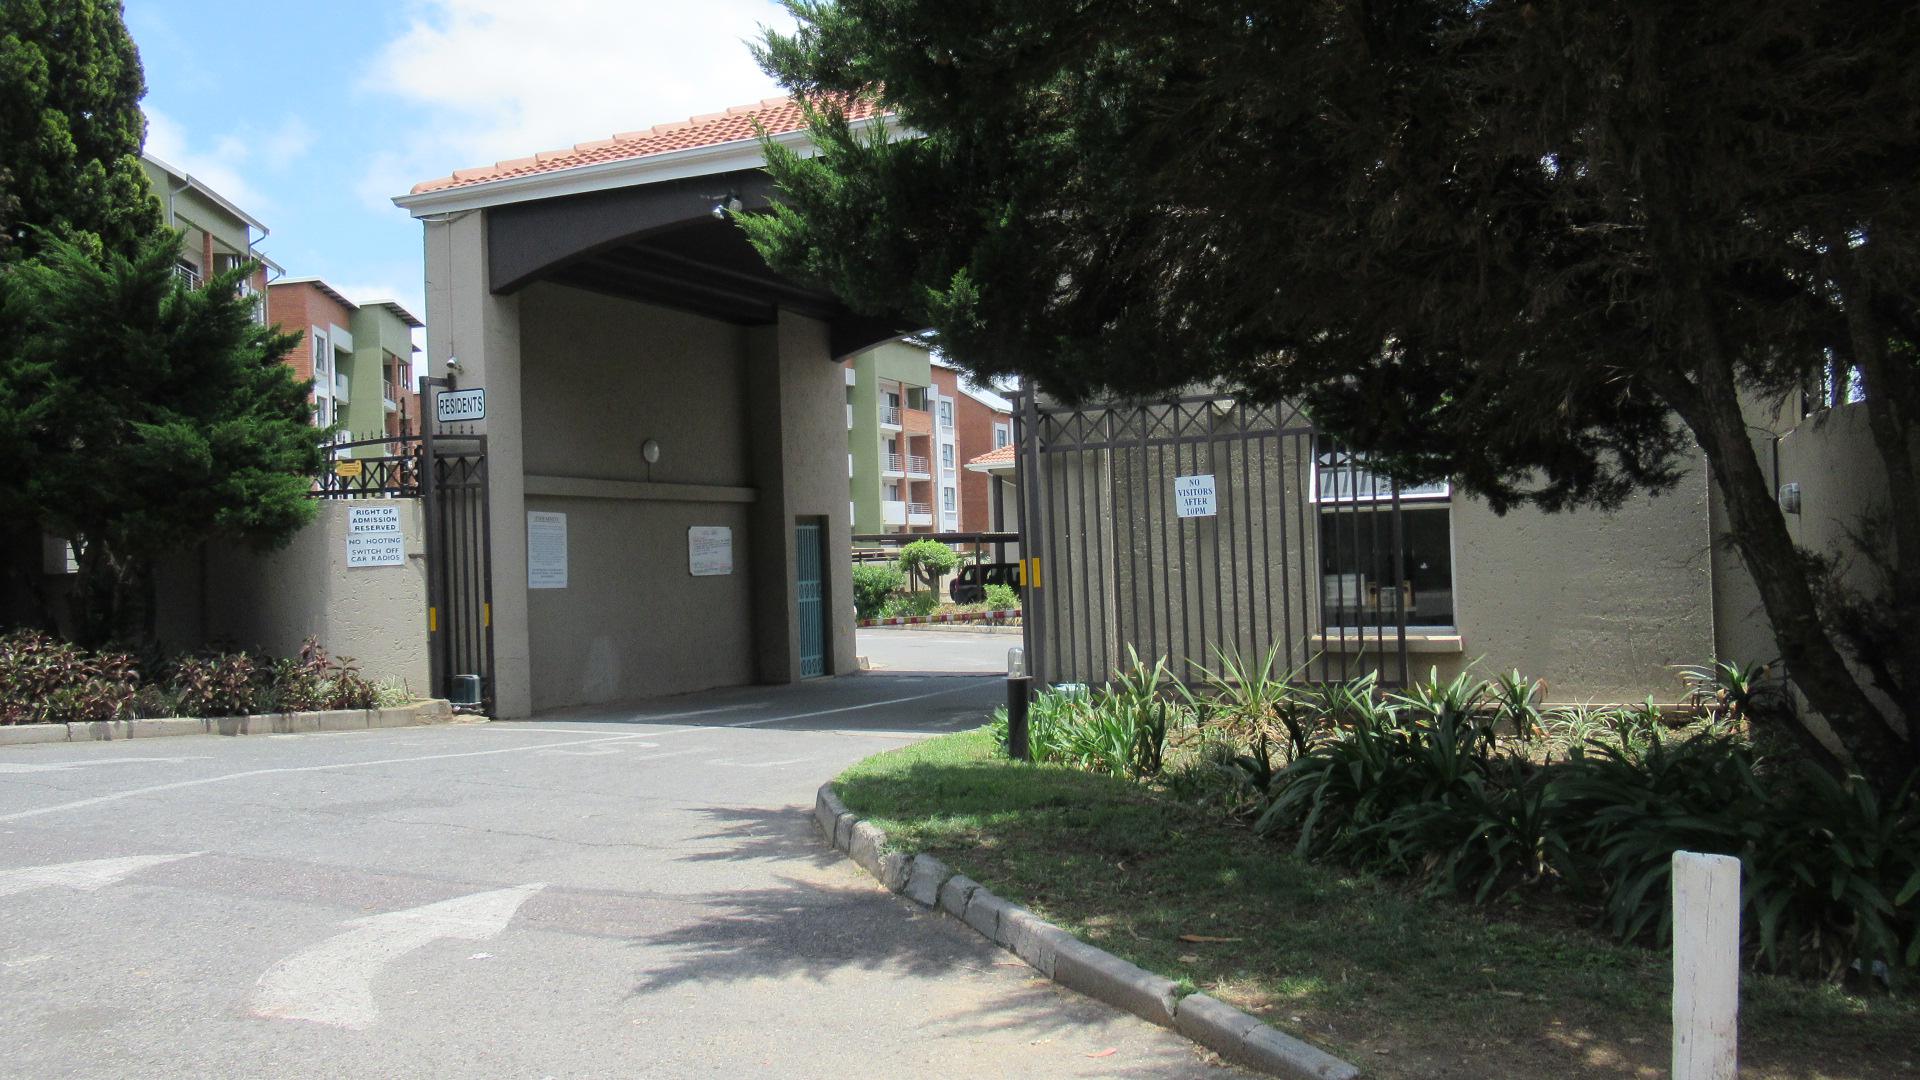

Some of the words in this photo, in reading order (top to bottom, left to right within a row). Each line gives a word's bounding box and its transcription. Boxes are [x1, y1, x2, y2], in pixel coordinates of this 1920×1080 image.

[439, 396, 483, 415] RESIDENTS
[1177, 488, 1213, 496] VISITORS
[1184, 497, 1208, 506] AFTER
[1186, 507, 1206, 515] 10PM
